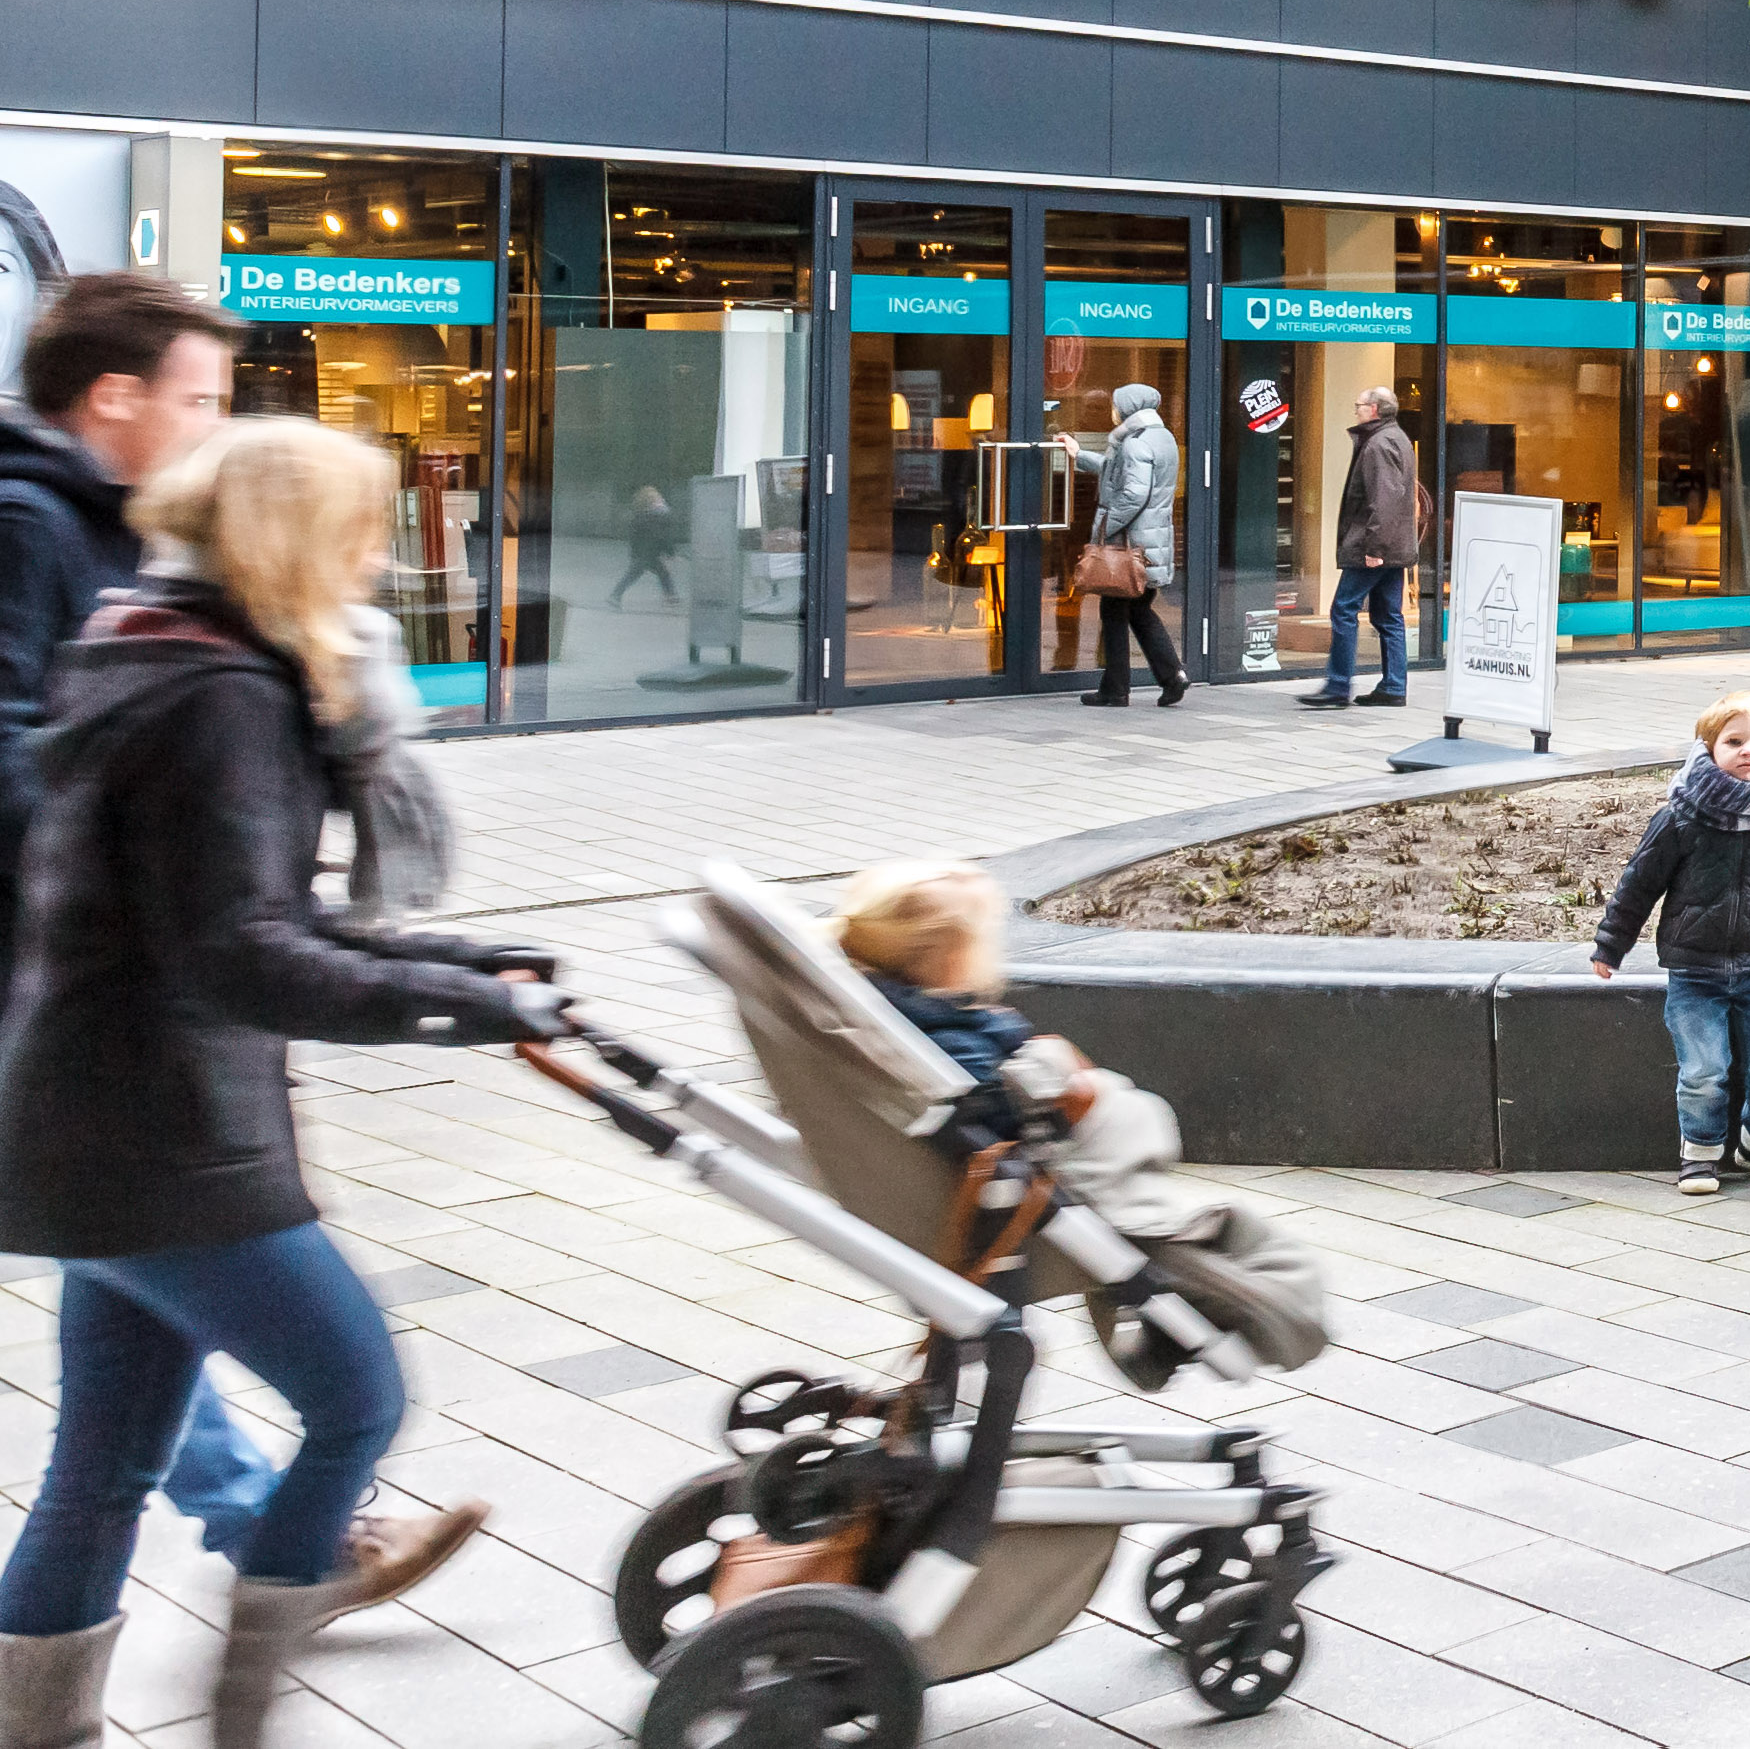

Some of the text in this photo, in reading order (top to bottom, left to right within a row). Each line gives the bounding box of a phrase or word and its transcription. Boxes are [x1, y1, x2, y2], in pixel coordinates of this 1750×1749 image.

[240, 265, 462, 295] De Bedenkers
[240, 295, 460, 314] INTERIEURVORMGEVERS
[888, 297, 970, 315] INGANG
[1080, 302, 1153, 320] INGANG
[1276, 298, 1414, 321] De Bedenkers
[1276, 321, 1412, 335] INTERIEURVORMGEVERS
[1686, 312, 1708, 329] De
[1245, 386, 1279, 413] PLEIN
[1252, 630, 1270, 642] NU
[1464, 657, 1531, 678] -AANHUIS.NL
